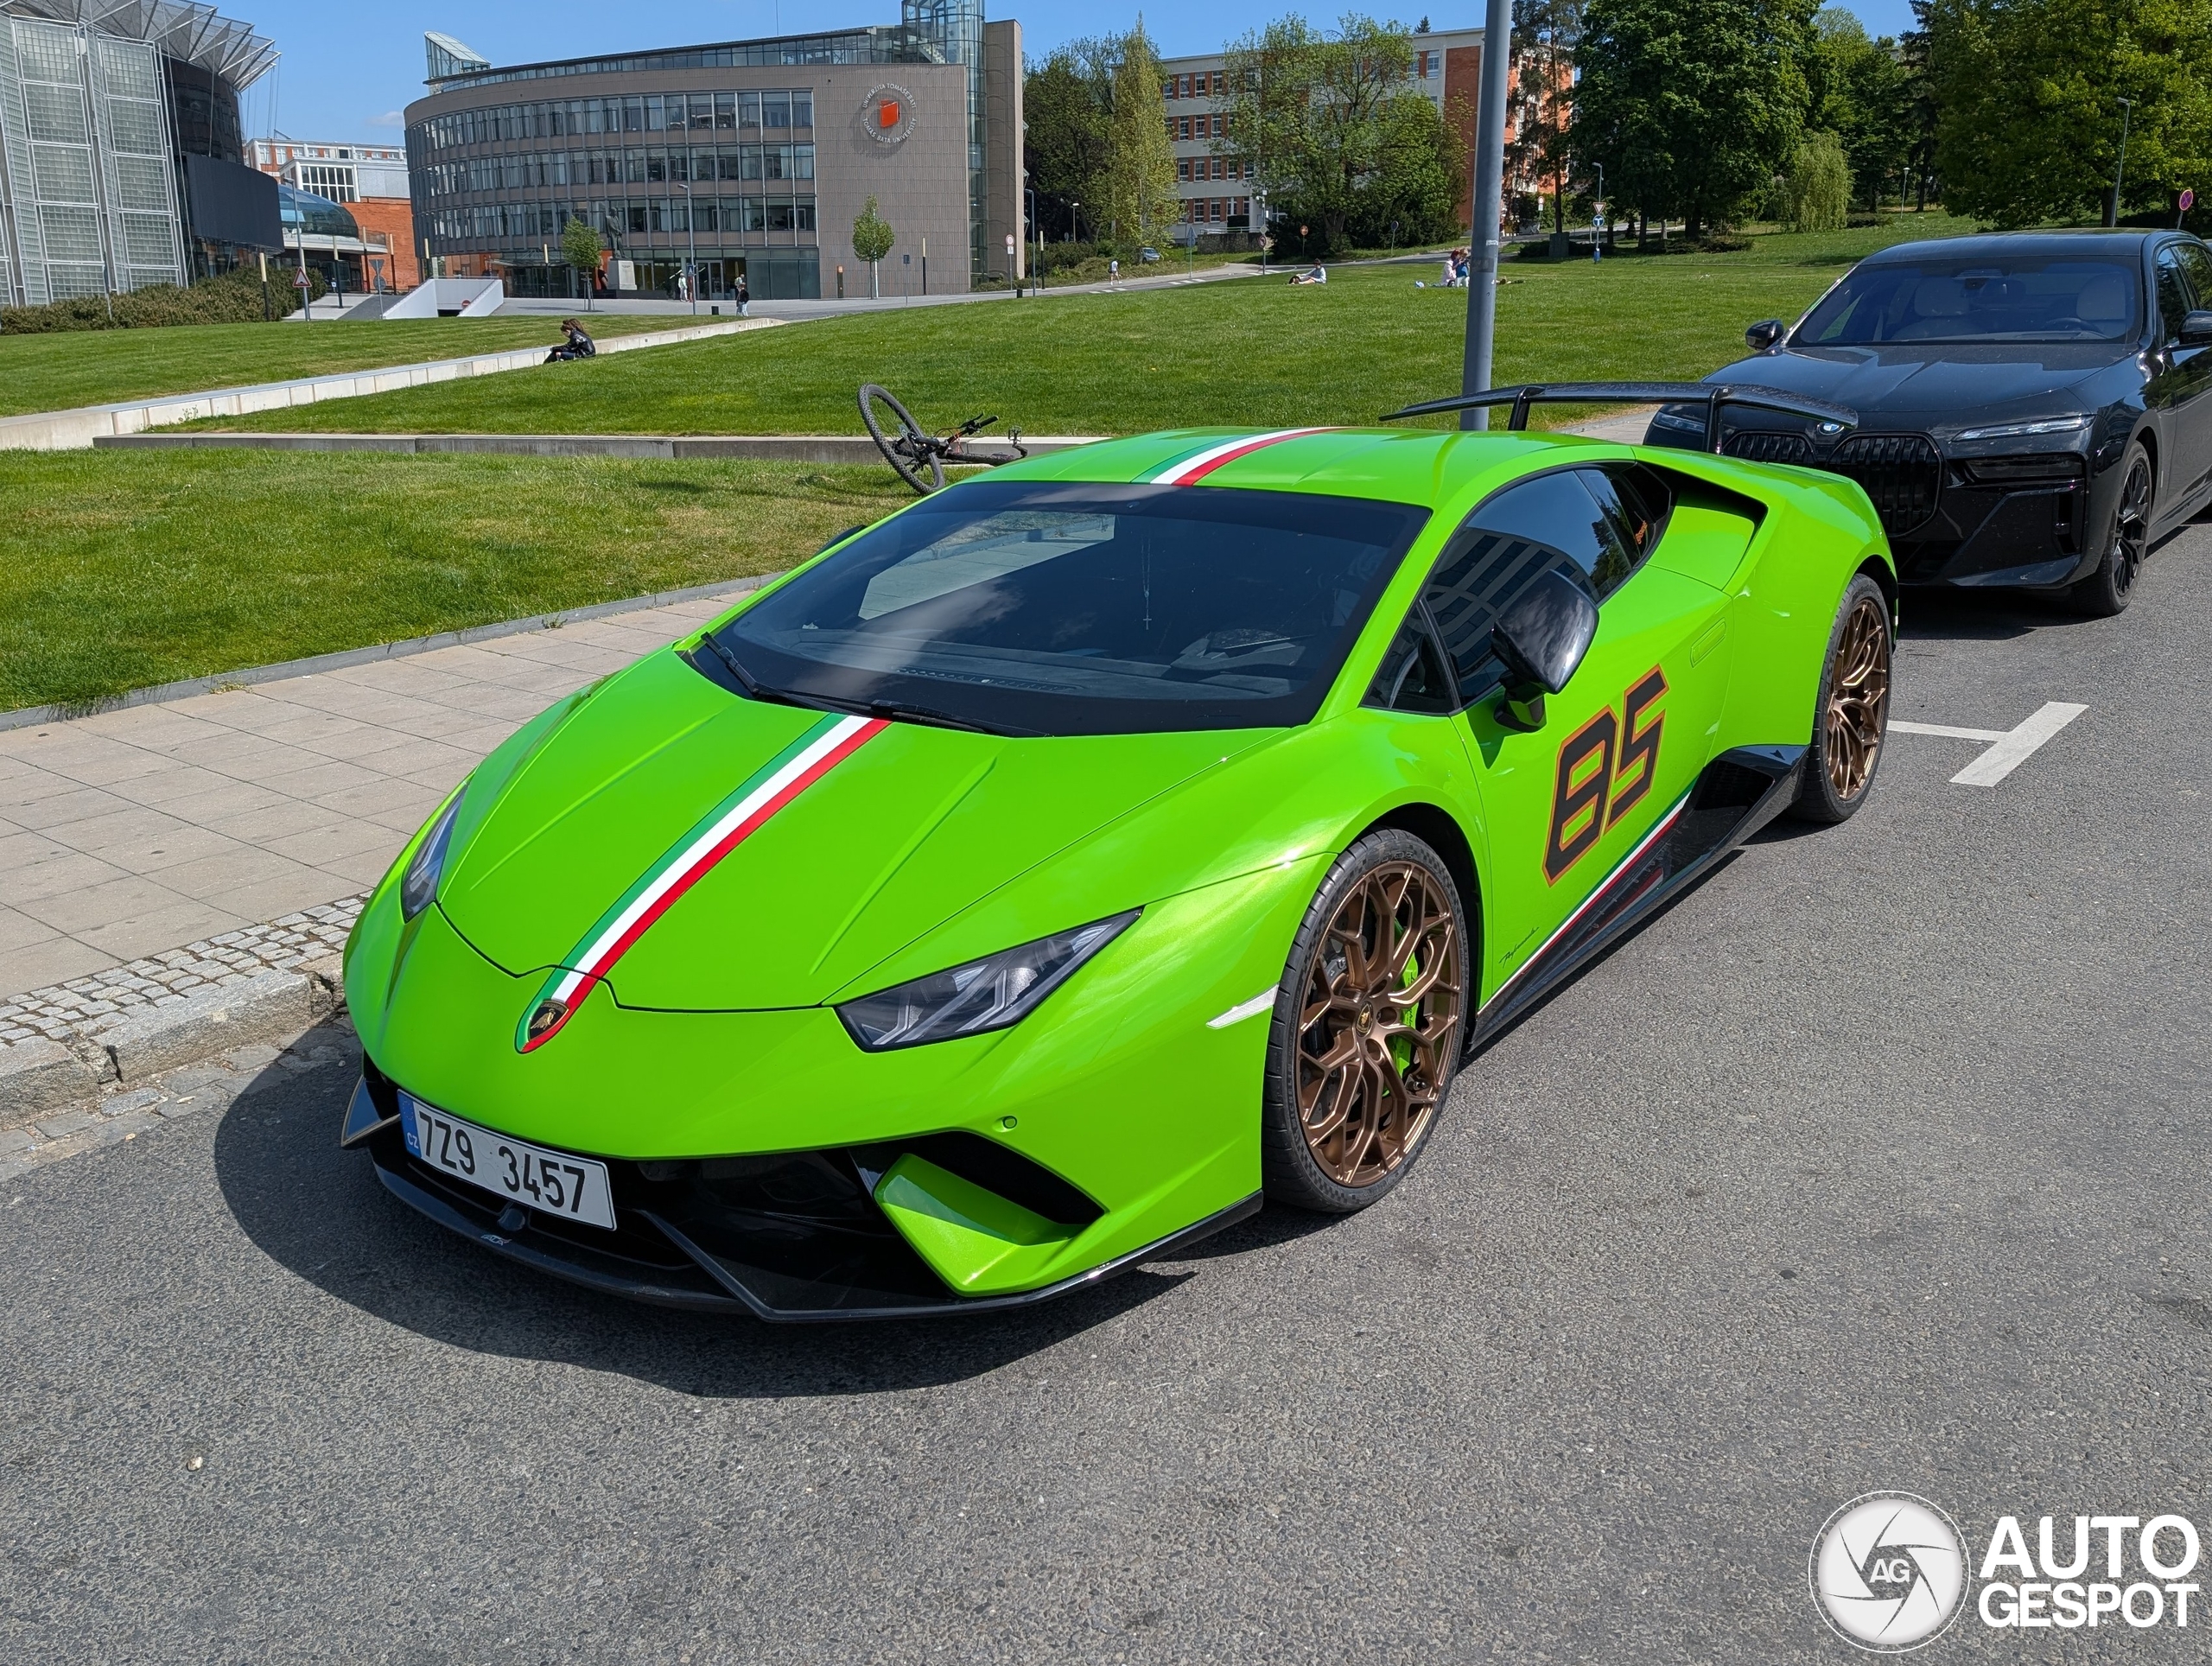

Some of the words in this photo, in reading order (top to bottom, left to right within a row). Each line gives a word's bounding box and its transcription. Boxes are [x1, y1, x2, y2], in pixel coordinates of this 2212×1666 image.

[877, 135, 891, 143] BATA
[893, 118, 917, 143] UNIVERSITY
[1542, 663, 1669, 887] 85
[1287, 1063, 1298, 1129] MICHELIN
[407, 1132, 419, 1149] CZ
[419, 1110, 476, 1175] 7Z9
[499, 1146, 586, 1213] 3457
